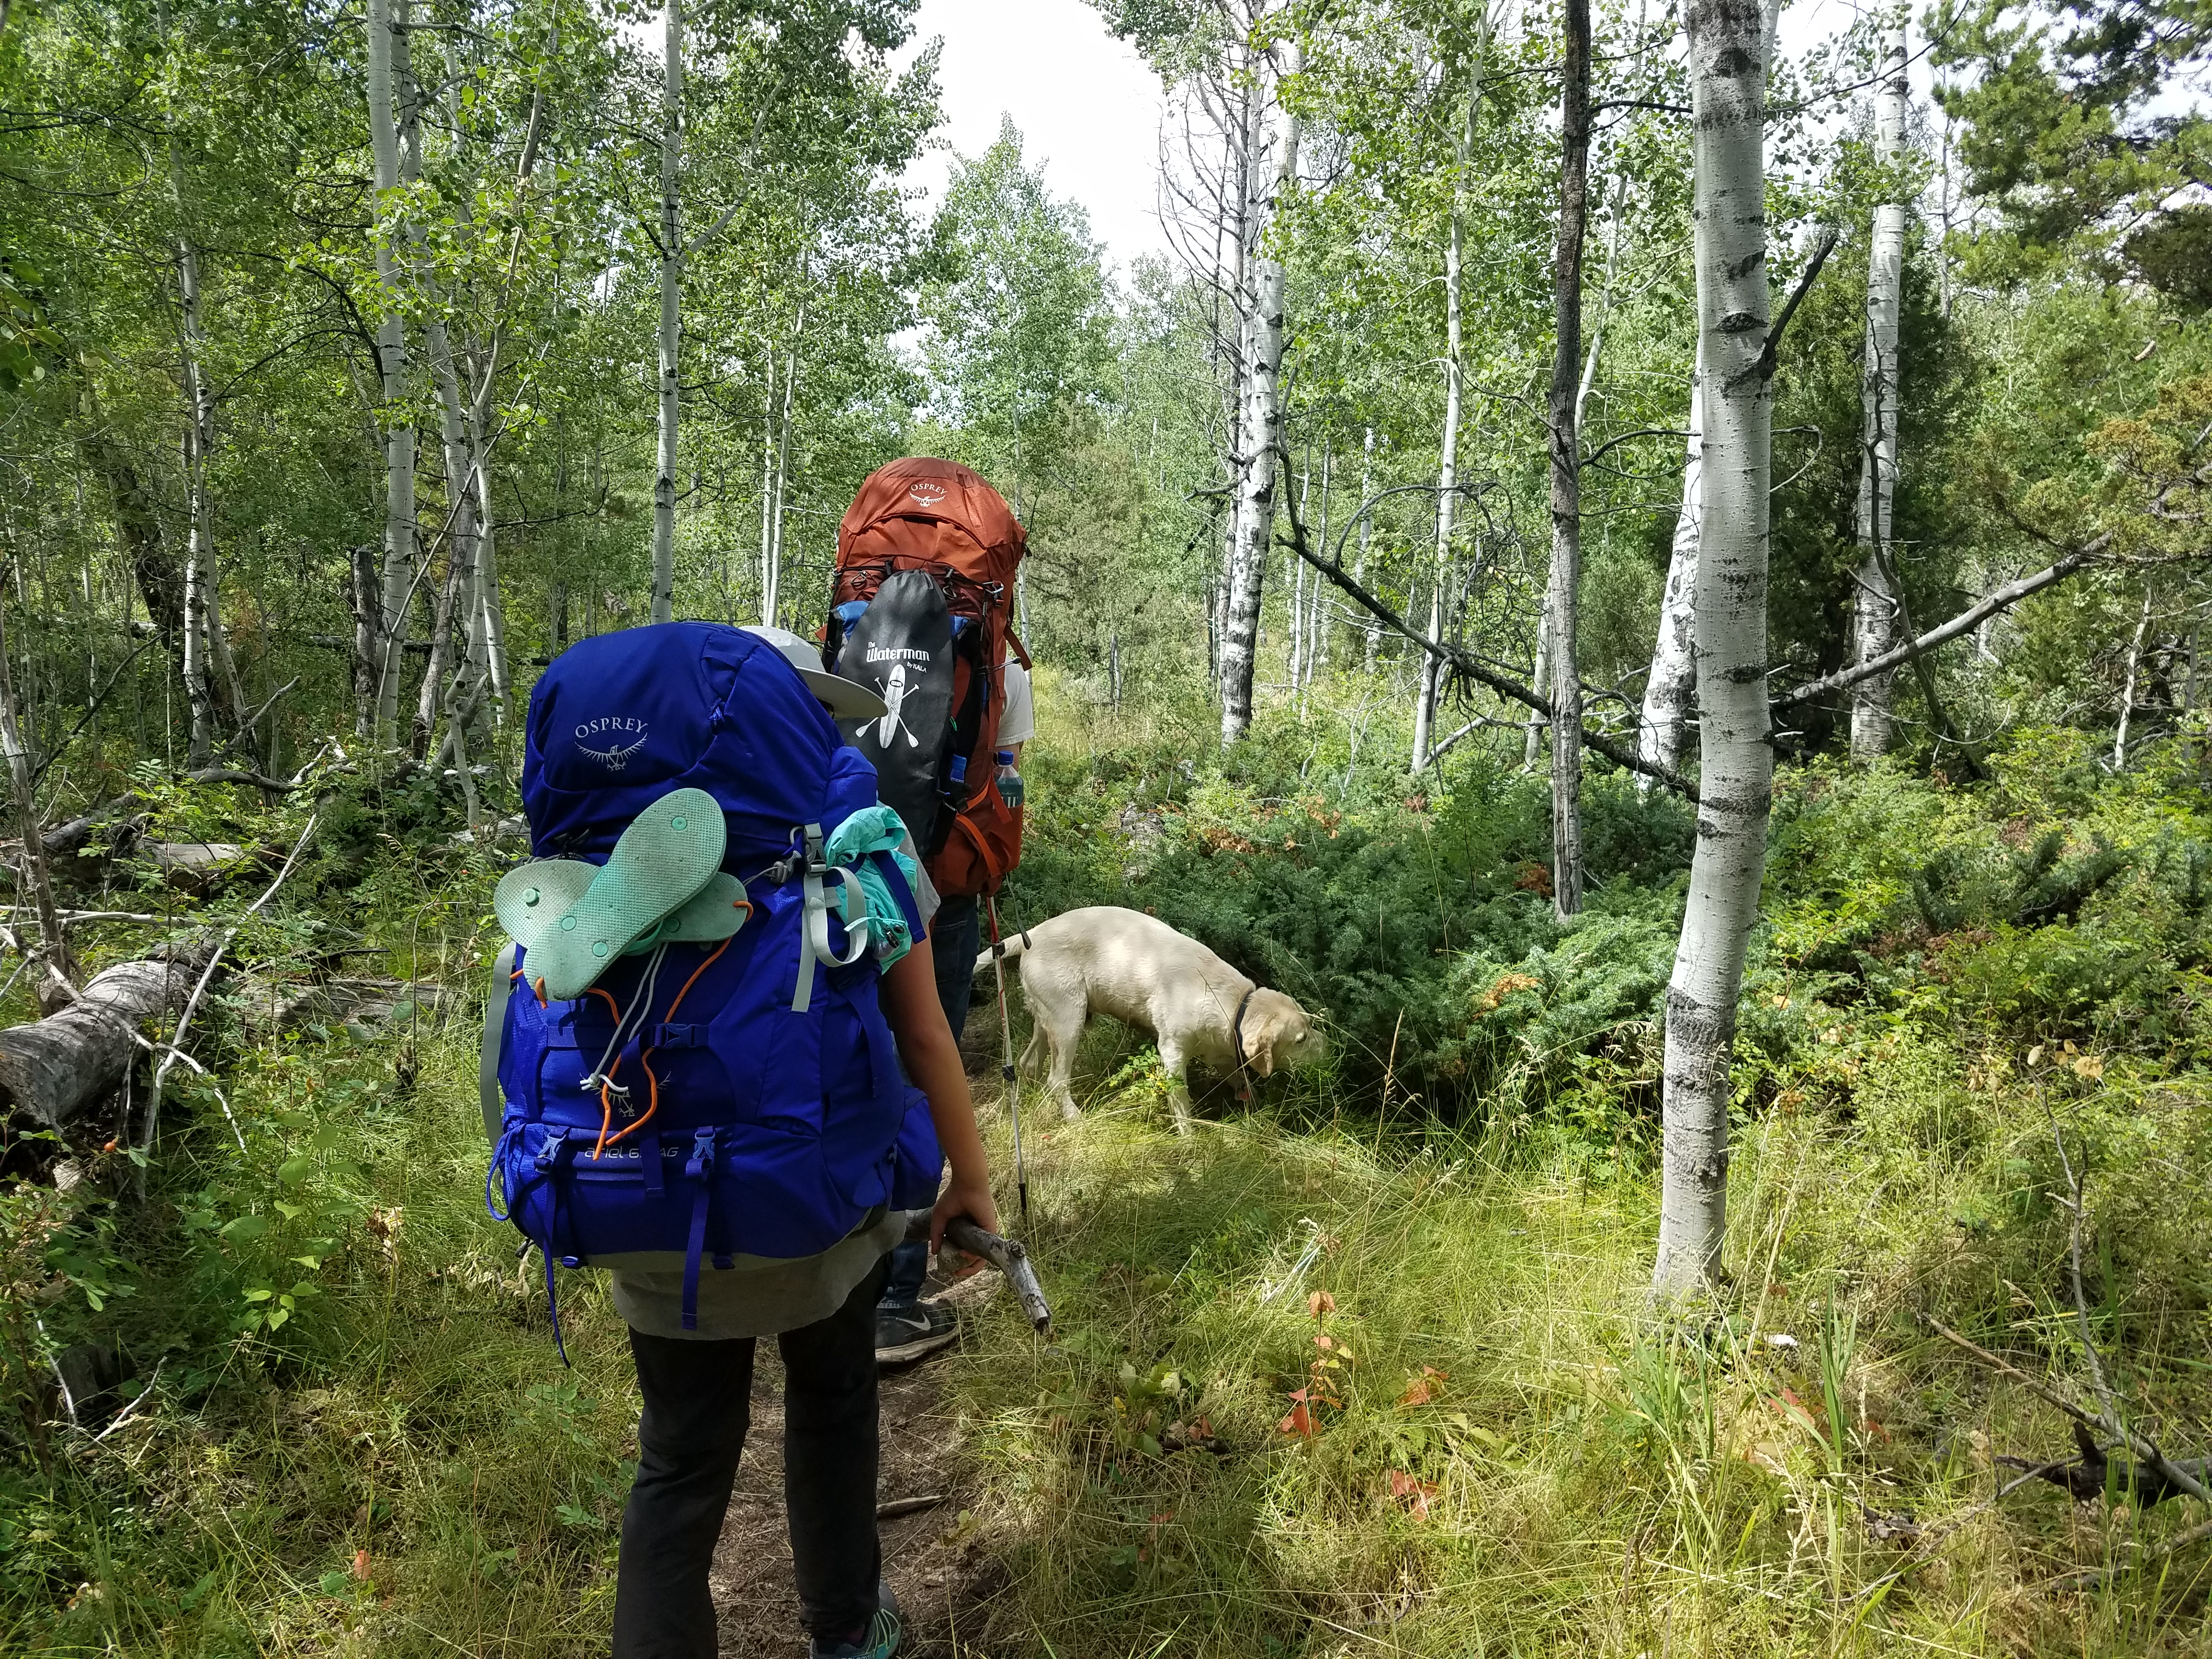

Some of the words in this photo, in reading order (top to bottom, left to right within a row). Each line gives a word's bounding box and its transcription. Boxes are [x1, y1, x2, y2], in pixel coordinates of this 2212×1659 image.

[911, 483, 947, 495] OSPREY
[866, 647, 930, 663] Waterman
[913, 663, 927, 673] KALA
[575, 716, 648, 738] OSPREY
[584, 1146, 624, 1159] aiel
